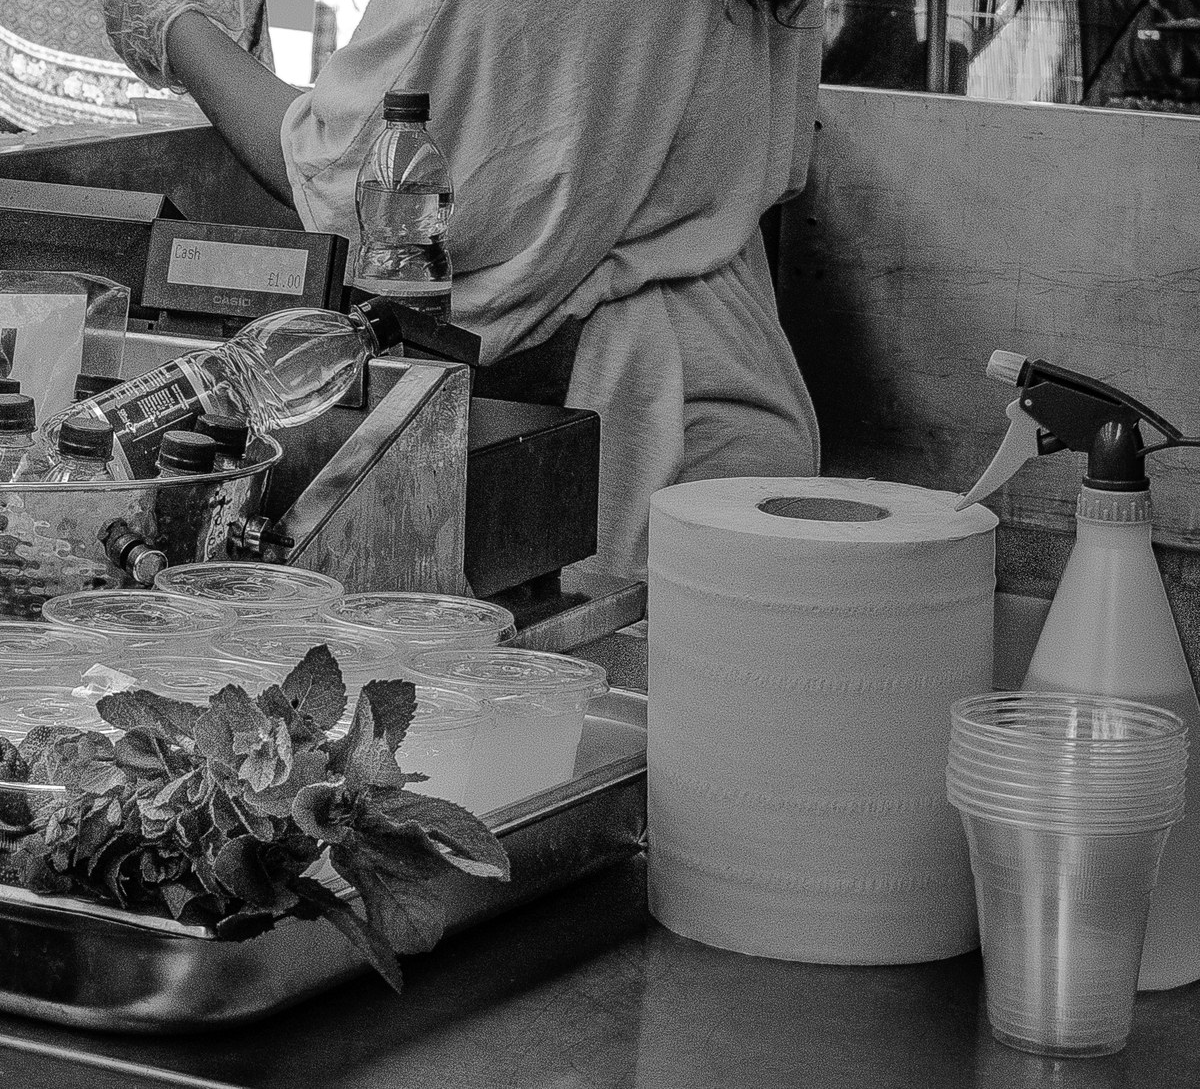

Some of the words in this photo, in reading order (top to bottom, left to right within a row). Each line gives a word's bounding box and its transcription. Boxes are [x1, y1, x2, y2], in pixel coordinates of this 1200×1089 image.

[174, 243, 201, 261] Cash
[267, 272, 301, 289] £1.00
[212, 295, 251, 307] CASIO
